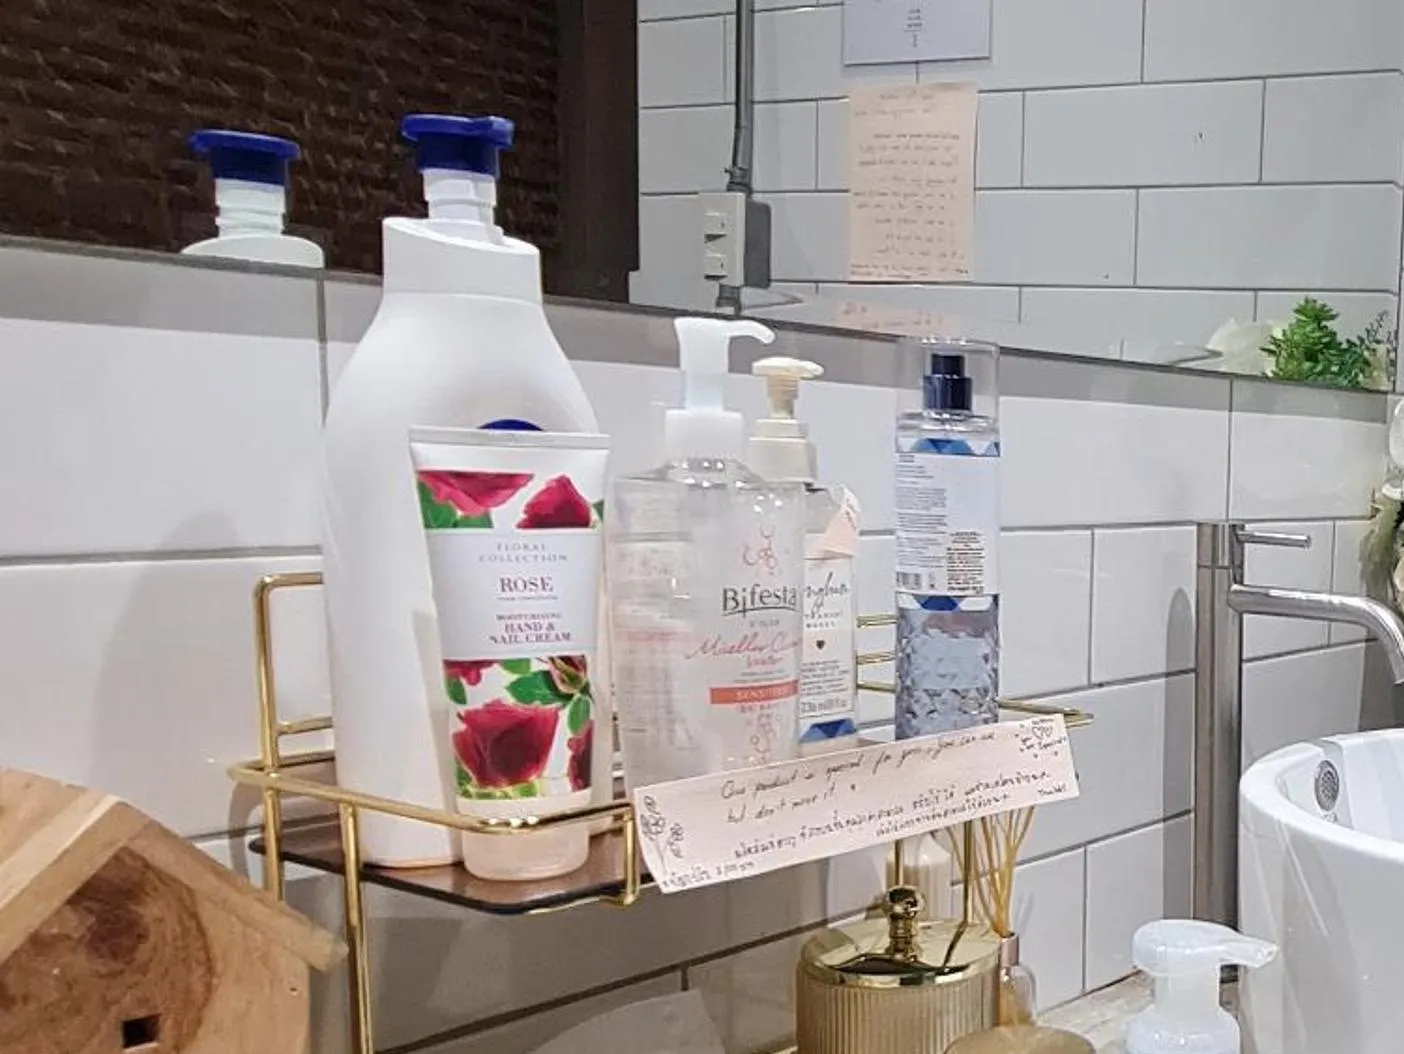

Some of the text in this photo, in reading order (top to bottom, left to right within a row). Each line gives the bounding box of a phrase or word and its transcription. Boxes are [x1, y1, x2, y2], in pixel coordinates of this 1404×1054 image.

[499, 575, 555, 593] ROSE
[722, 584, 798, 618] Bifesta
[504, 622, 556, 634] HAND &
[489, 631, 571, 645] NAIL CREAM
